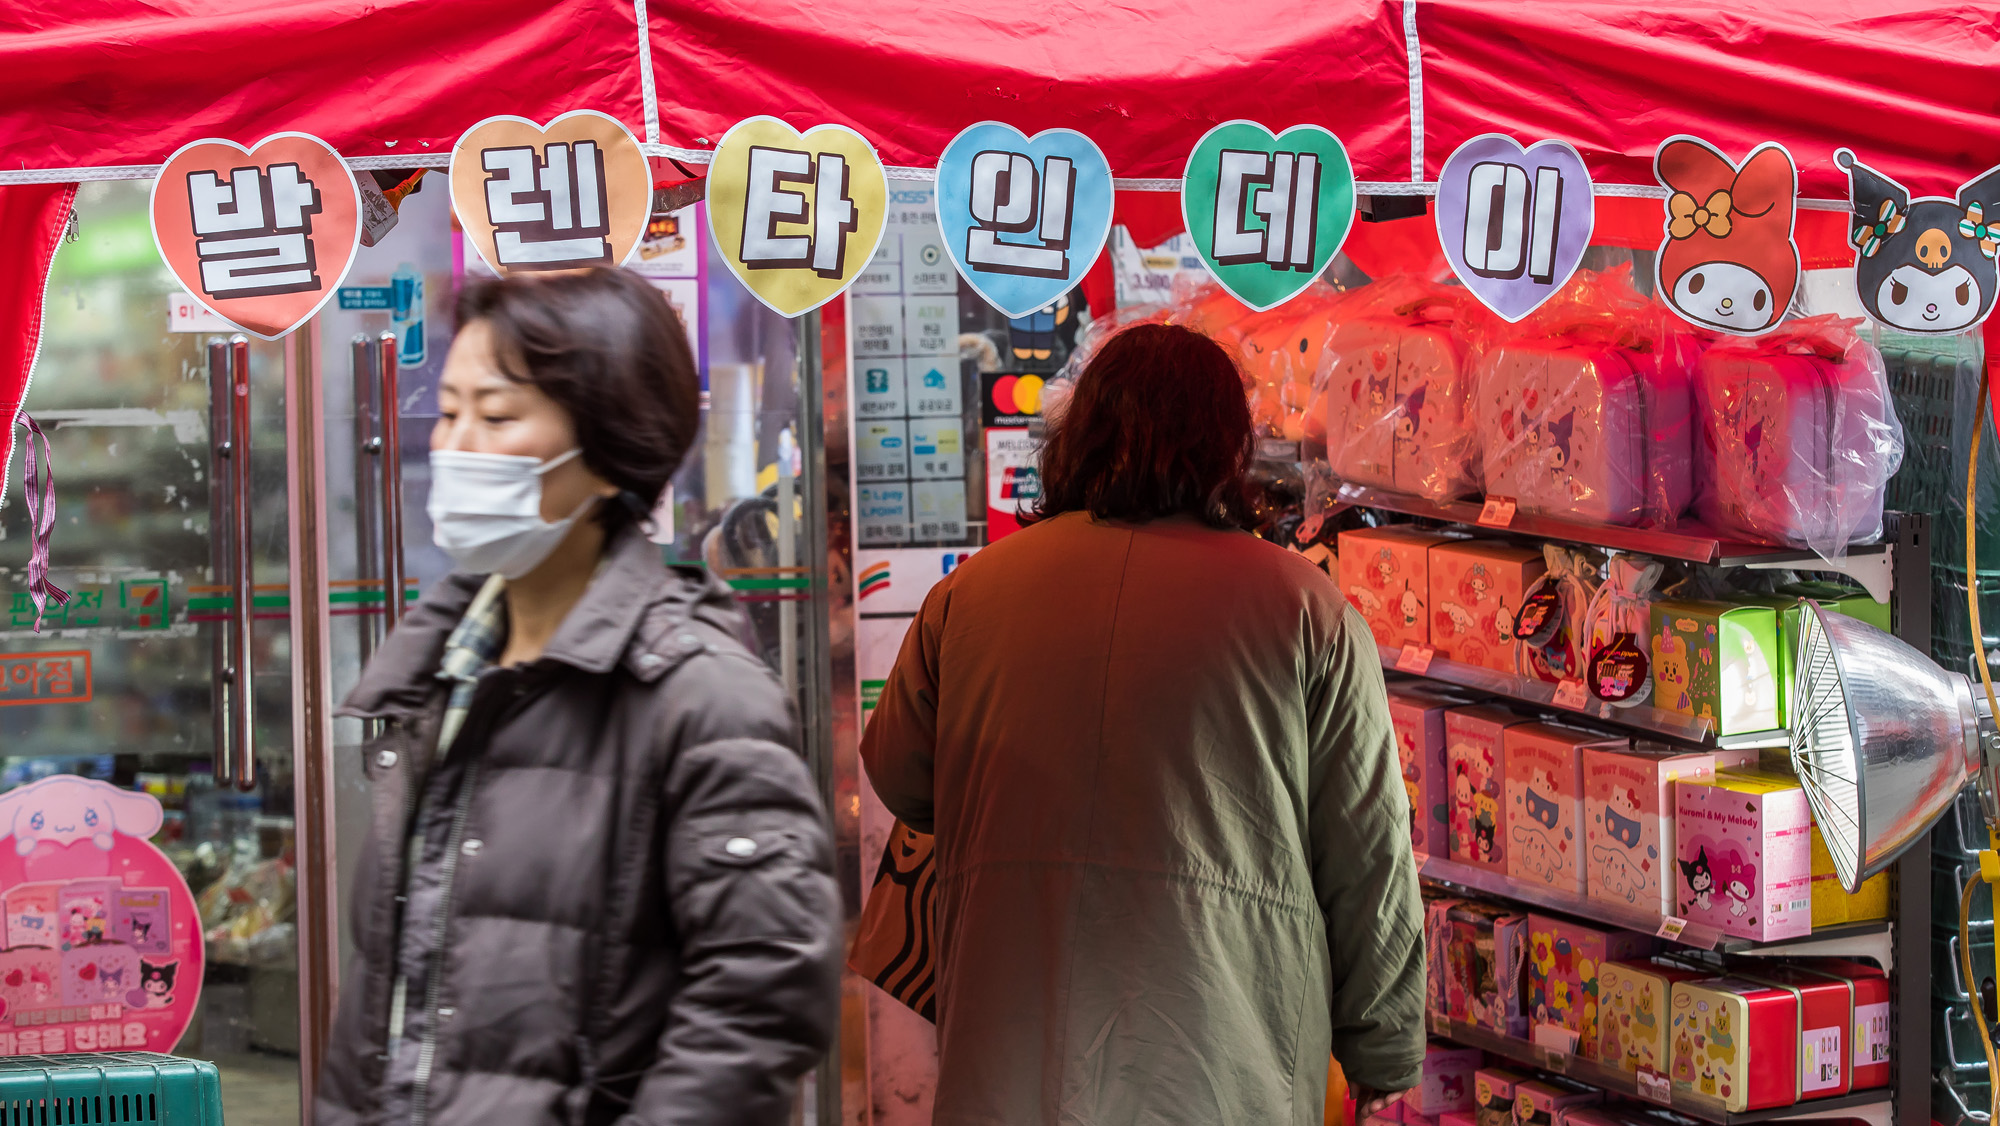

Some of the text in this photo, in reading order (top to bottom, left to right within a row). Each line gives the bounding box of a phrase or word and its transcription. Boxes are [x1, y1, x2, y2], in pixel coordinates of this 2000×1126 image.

[187, 139, 1564, 299] 발 렌 타 인 데 이
[918, 306, 945, 318] ATM
[923, 323, 941, 336] 현금
[919, 338, 946, 350] 지급기
[918, 399, 952, 412] 공공요금
[1679, 805, 1758, 829] Kuromi & My Melody
[74, 1021, 148, 1050] 전해요
